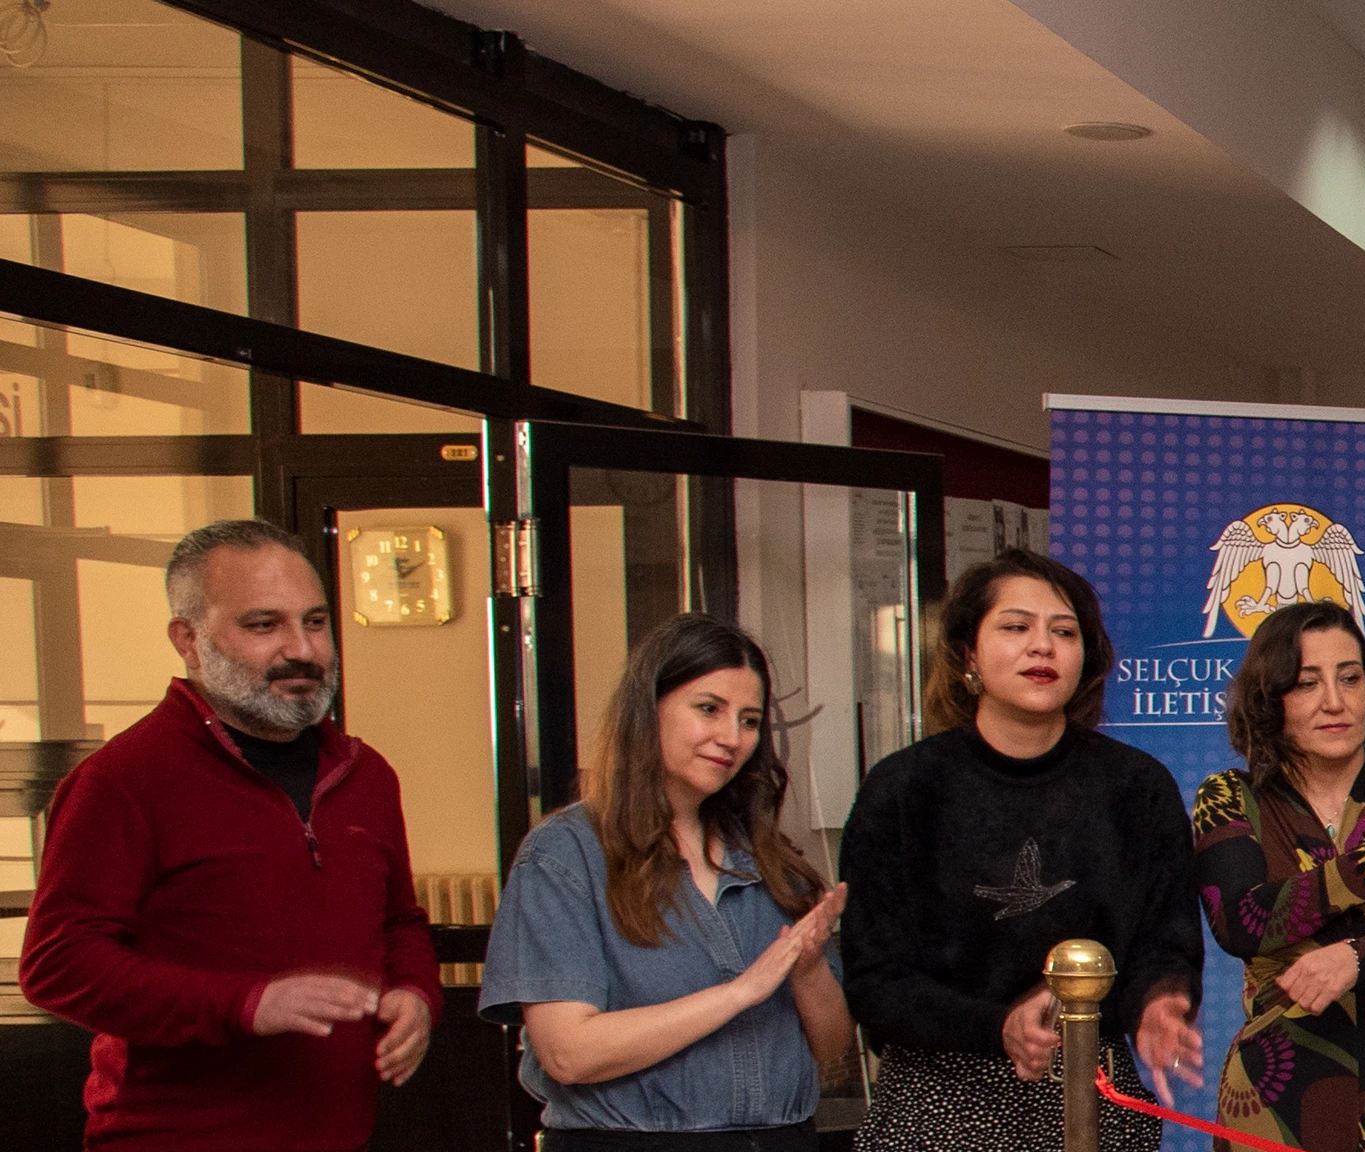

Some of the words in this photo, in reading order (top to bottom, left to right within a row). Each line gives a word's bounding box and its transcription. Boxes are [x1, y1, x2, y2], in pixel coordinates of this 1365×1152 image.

[379, 541, 391, 553] 11
[395, 536, 408, 549] 12
[415, 540, 421, 552] 1
[366, 555, 379, 567] 10
[428, 553, 436, 565] 2
[361, 571, 370, 583] 9
[436, 569, 444, 582] 3
[369, 590, 378, 602] 8
[430, 588, 439, 600] 4
[385, 600, 393, 613] 7
[401, 604, 410, 616] 6
[416, 600, 425, 613] 5
[1117, 658, 1236, 687] SELÇUK
